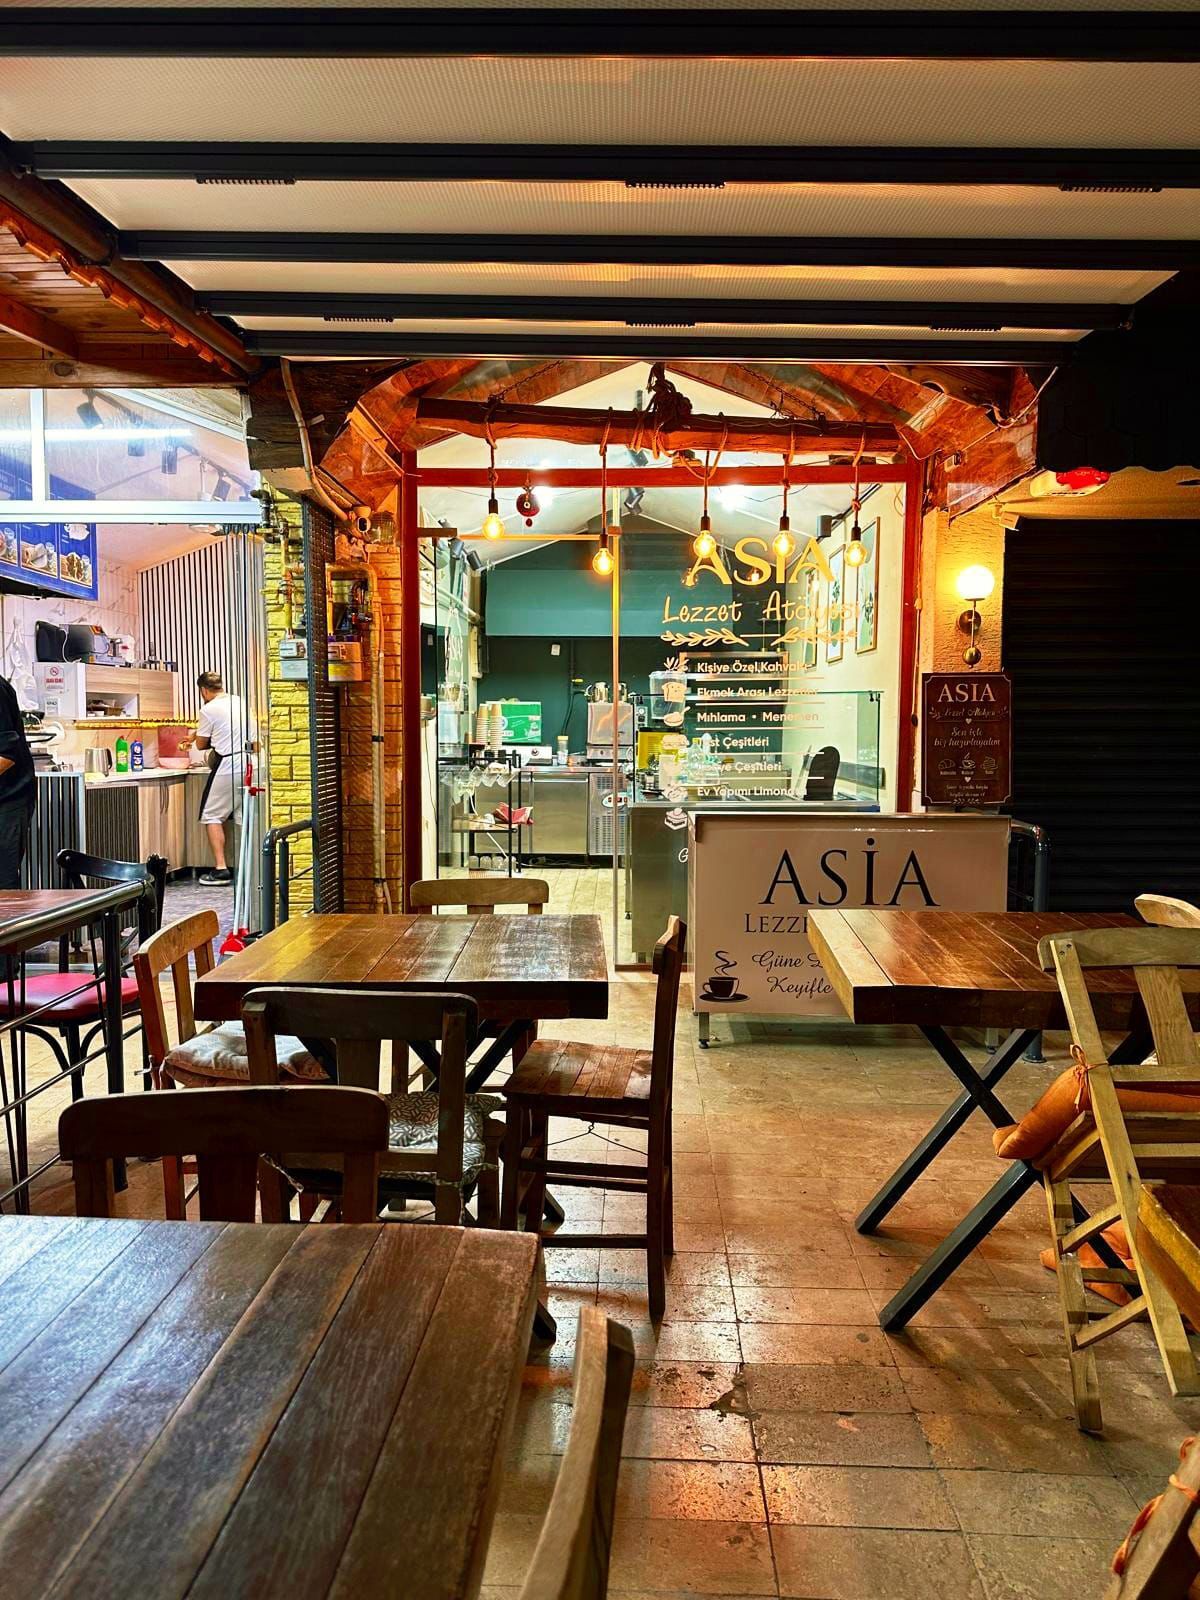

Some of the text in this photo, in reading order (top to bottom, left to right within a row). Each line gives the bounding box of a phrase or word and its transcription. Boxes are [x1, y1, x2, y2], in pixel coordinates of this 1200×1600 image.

[662, 596, 743, 623] Lezzet
[697, 662, 729, 674] Kişiye
[733, 660, 758, 672] Özel
[697, 688, 734, 698] Ekmek
[738, 687, 765, 697] Arası
[938, 683, 996, 702] ASIA
[697, 712, 819, 722] Mıhlama Menemen
[723, 737, 769, 748] Çeşitleri
[736, 761, 781, 773] Çeşitleri
[697, 787, 710, 796] Ev
[713, 787, 750, 798] Yapımı
[752, 951, 804, 972] Güne
[767, 976, 833, 998] Keyifle
